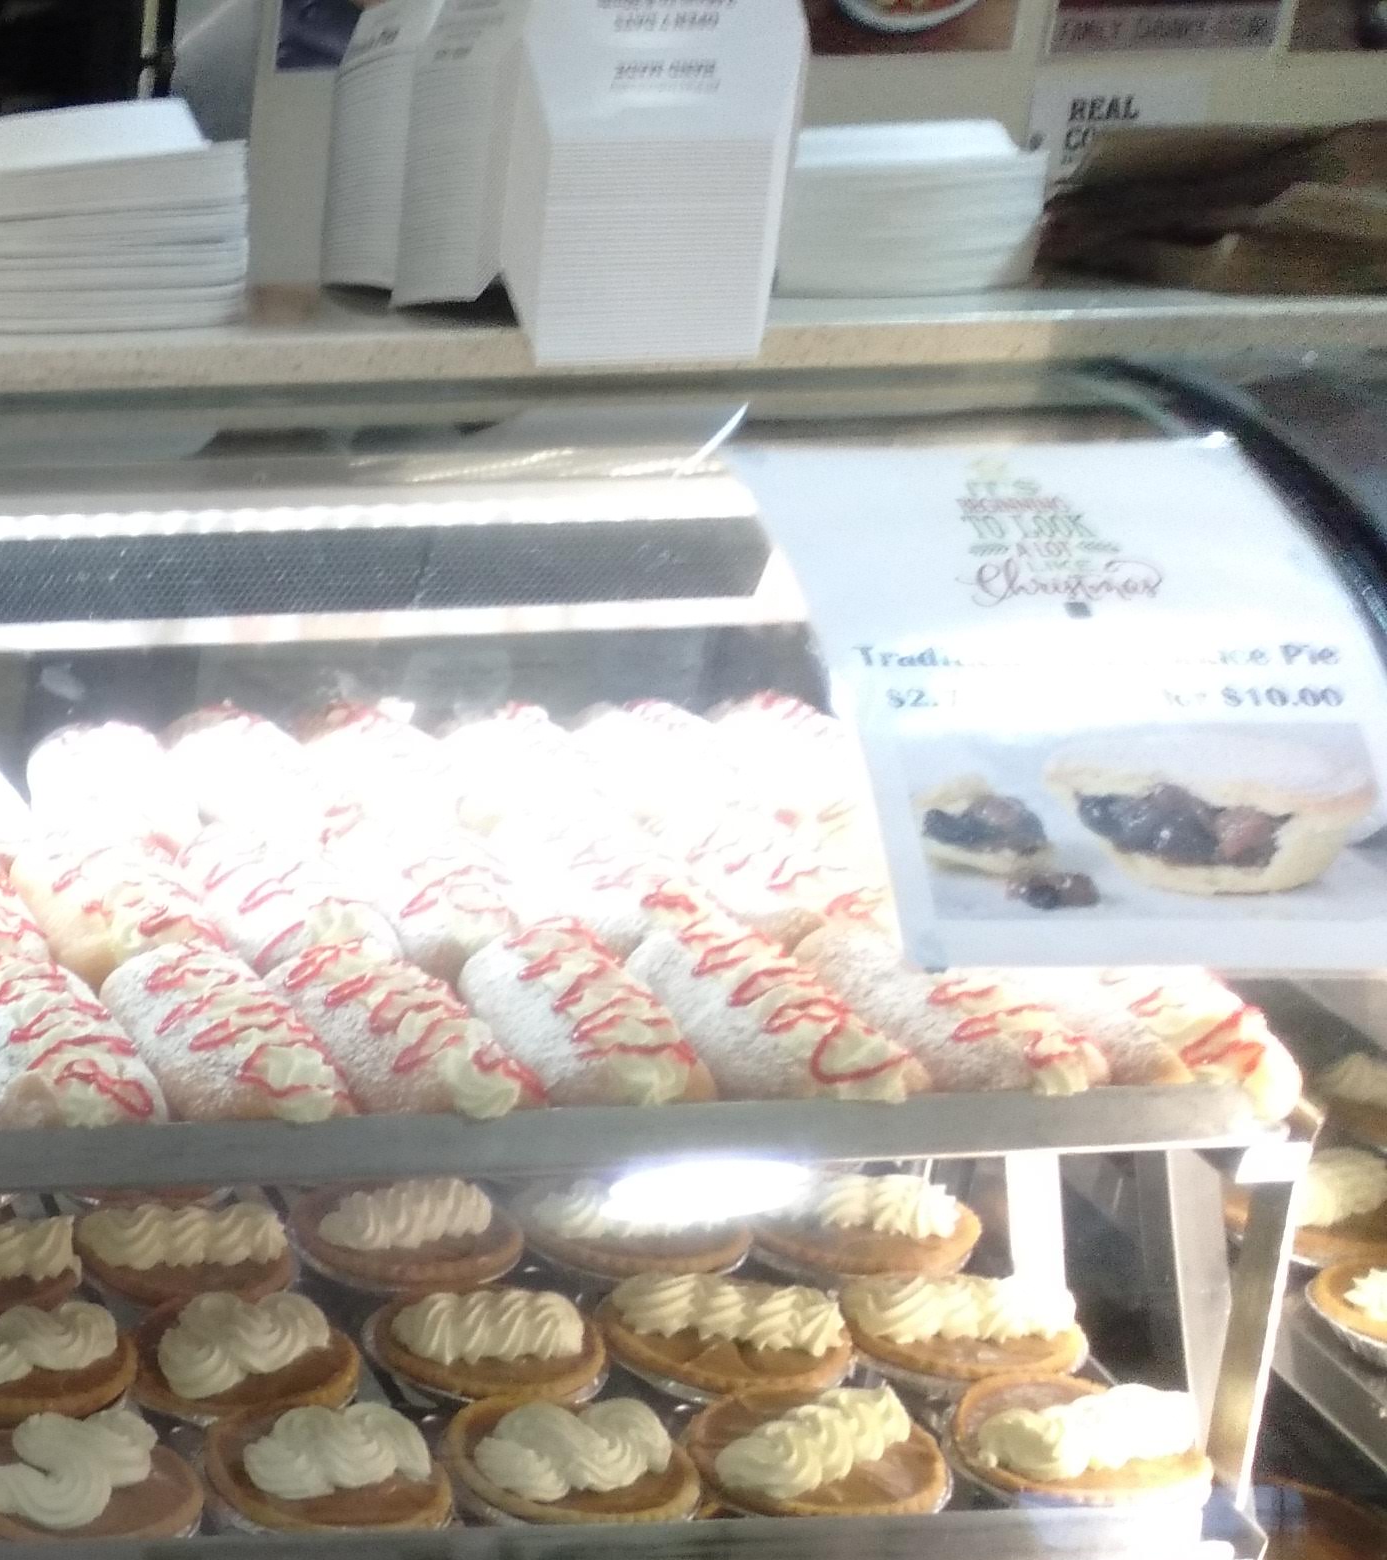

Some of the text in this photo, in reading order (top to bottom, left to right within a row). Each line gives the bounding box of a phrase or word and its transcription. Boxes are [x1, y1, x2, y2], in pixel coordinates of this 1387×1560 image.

[1068, 94, 1140, 121] REAL
[955, 556, 1163, 607] Christmas
[1279, 640, 1341, 665] Pie
[1221, 684, 1346, 708] $10.00
